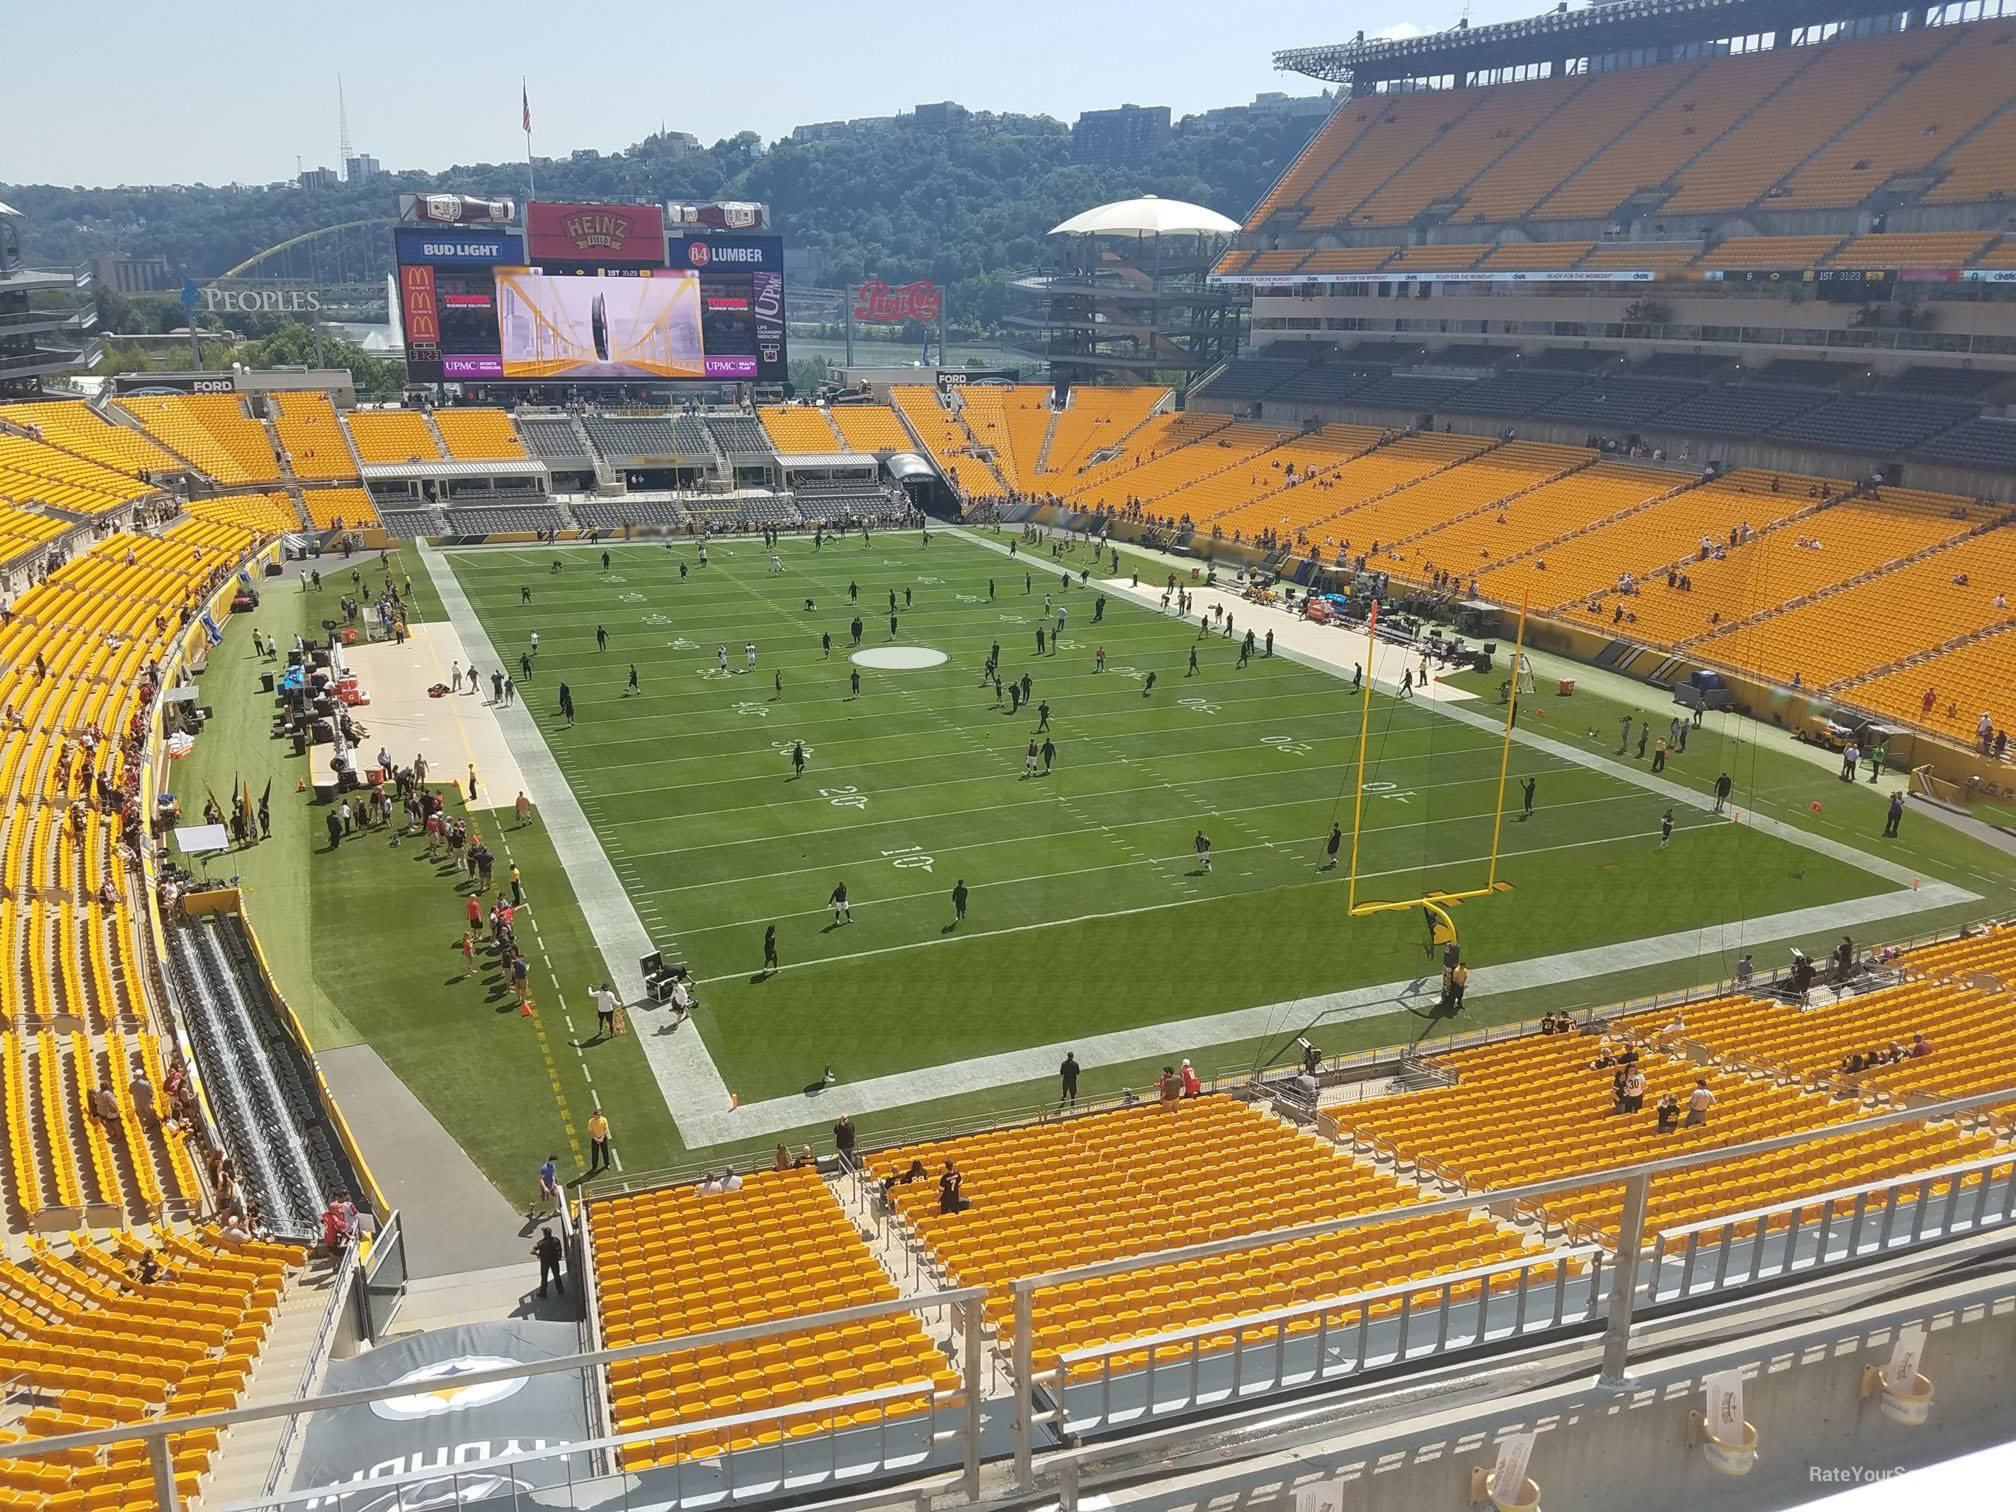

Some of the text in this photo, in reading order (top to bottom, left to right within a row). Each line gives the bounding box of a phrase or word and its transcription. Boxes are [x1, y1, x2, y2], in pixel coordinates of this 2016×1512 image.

[567, 215, 627, 238] HEINZ
[591, 235, 609, 246] FIELD
[423, 243, 499, 256] BUD LIGHT
[691, 248, 763, 262] 84 LUMBER
[1819, 272, 1834, 281] 1ST
[1840, 272, 1861, 281] 31:23
[755, 274, 782, 316] UPMC
[445, 361, 477, 371] UPMC
[706, 361, 737, 371] UPMC
[939, 374, 967, 384] FORD
[193, 381, 232, 392] FORD
[1260, 736, 1313, 753] 20
[819, 785, 868, 806] 20
[1361, 782, 1418, 800] 10
[880, 846, 935, 868] 10
[1628, 1079, 1639, 1089] 30
[950, 1179, 957, 1192] 7
